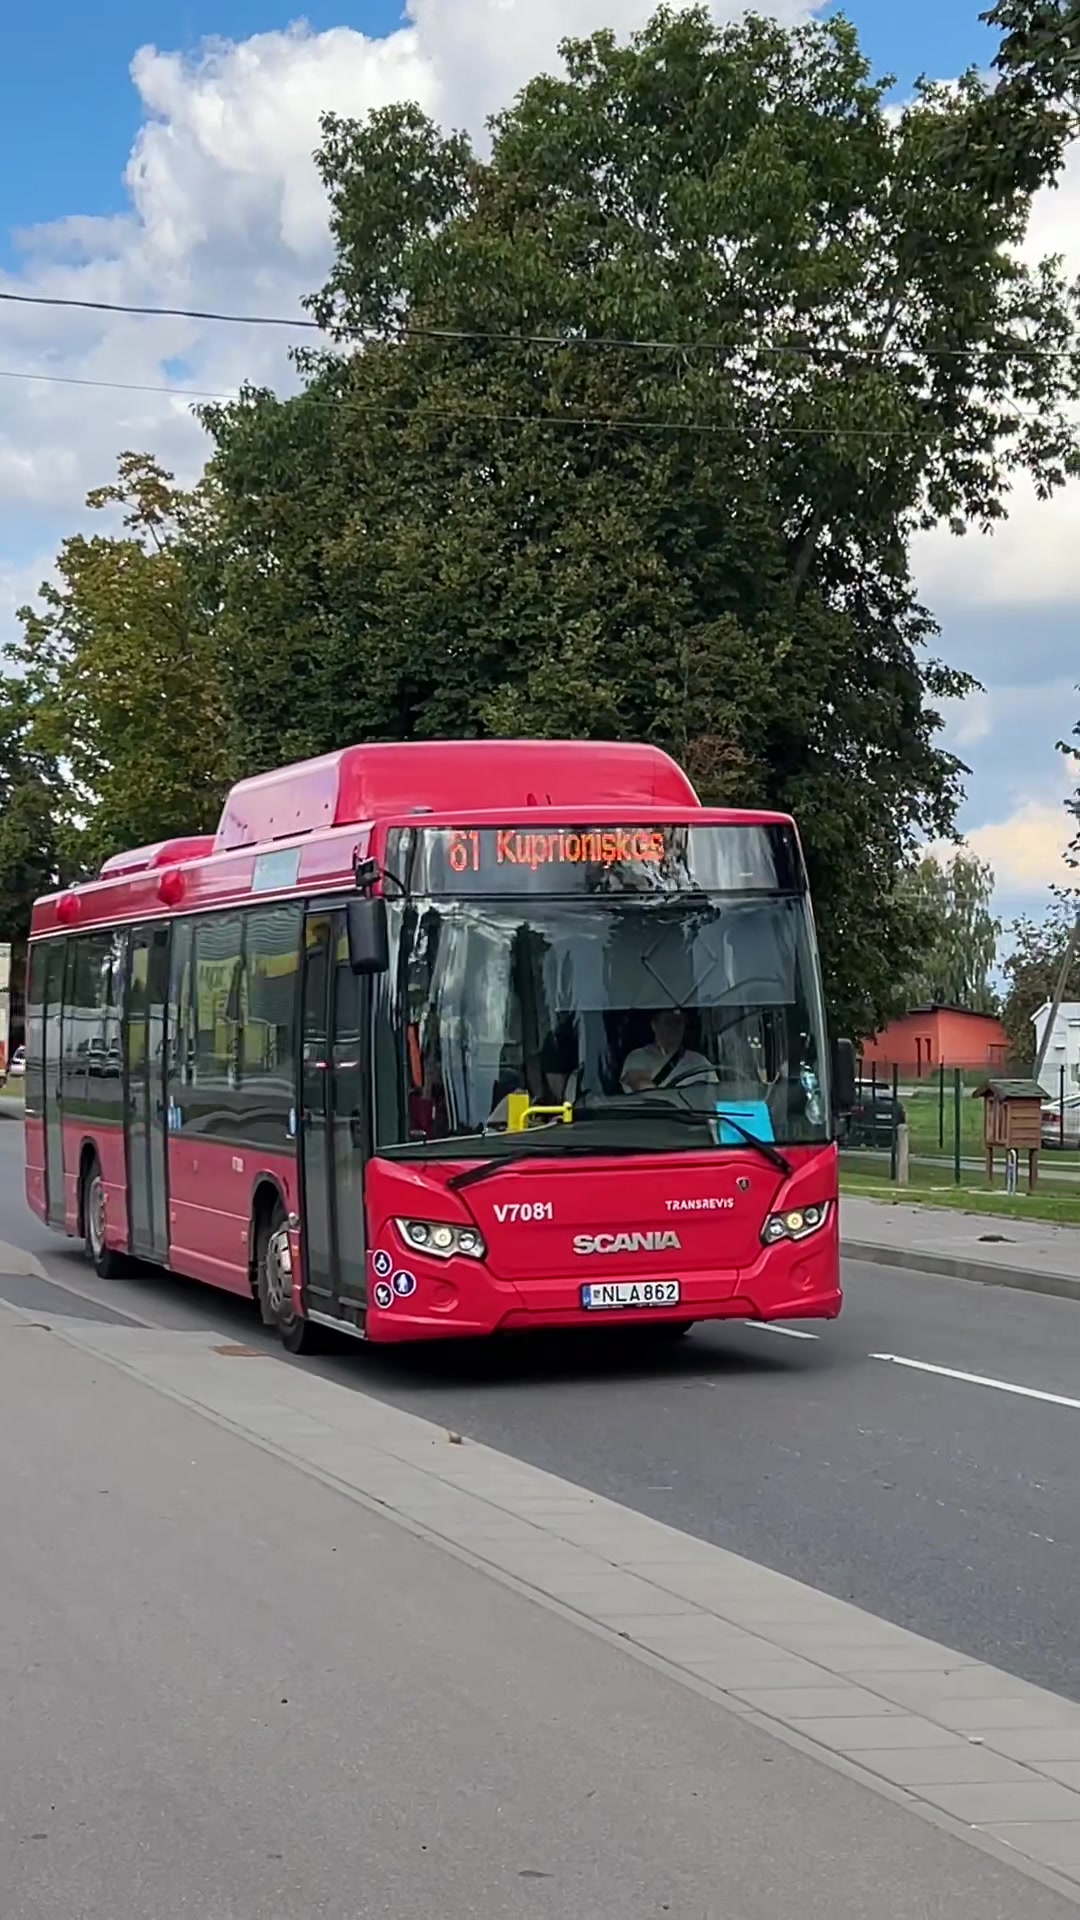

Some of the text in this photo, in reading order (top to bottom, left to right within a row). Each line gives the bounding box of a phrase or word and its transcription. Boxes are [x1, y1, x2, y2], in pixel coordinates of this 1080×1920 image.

[449, 829, 479, 871] 61
[493, 1202, 554, 1222] V7081
[665, 1198, 735, 1211] TRANSREVIS
[573, 1230, 682, 1255] SCANIA
